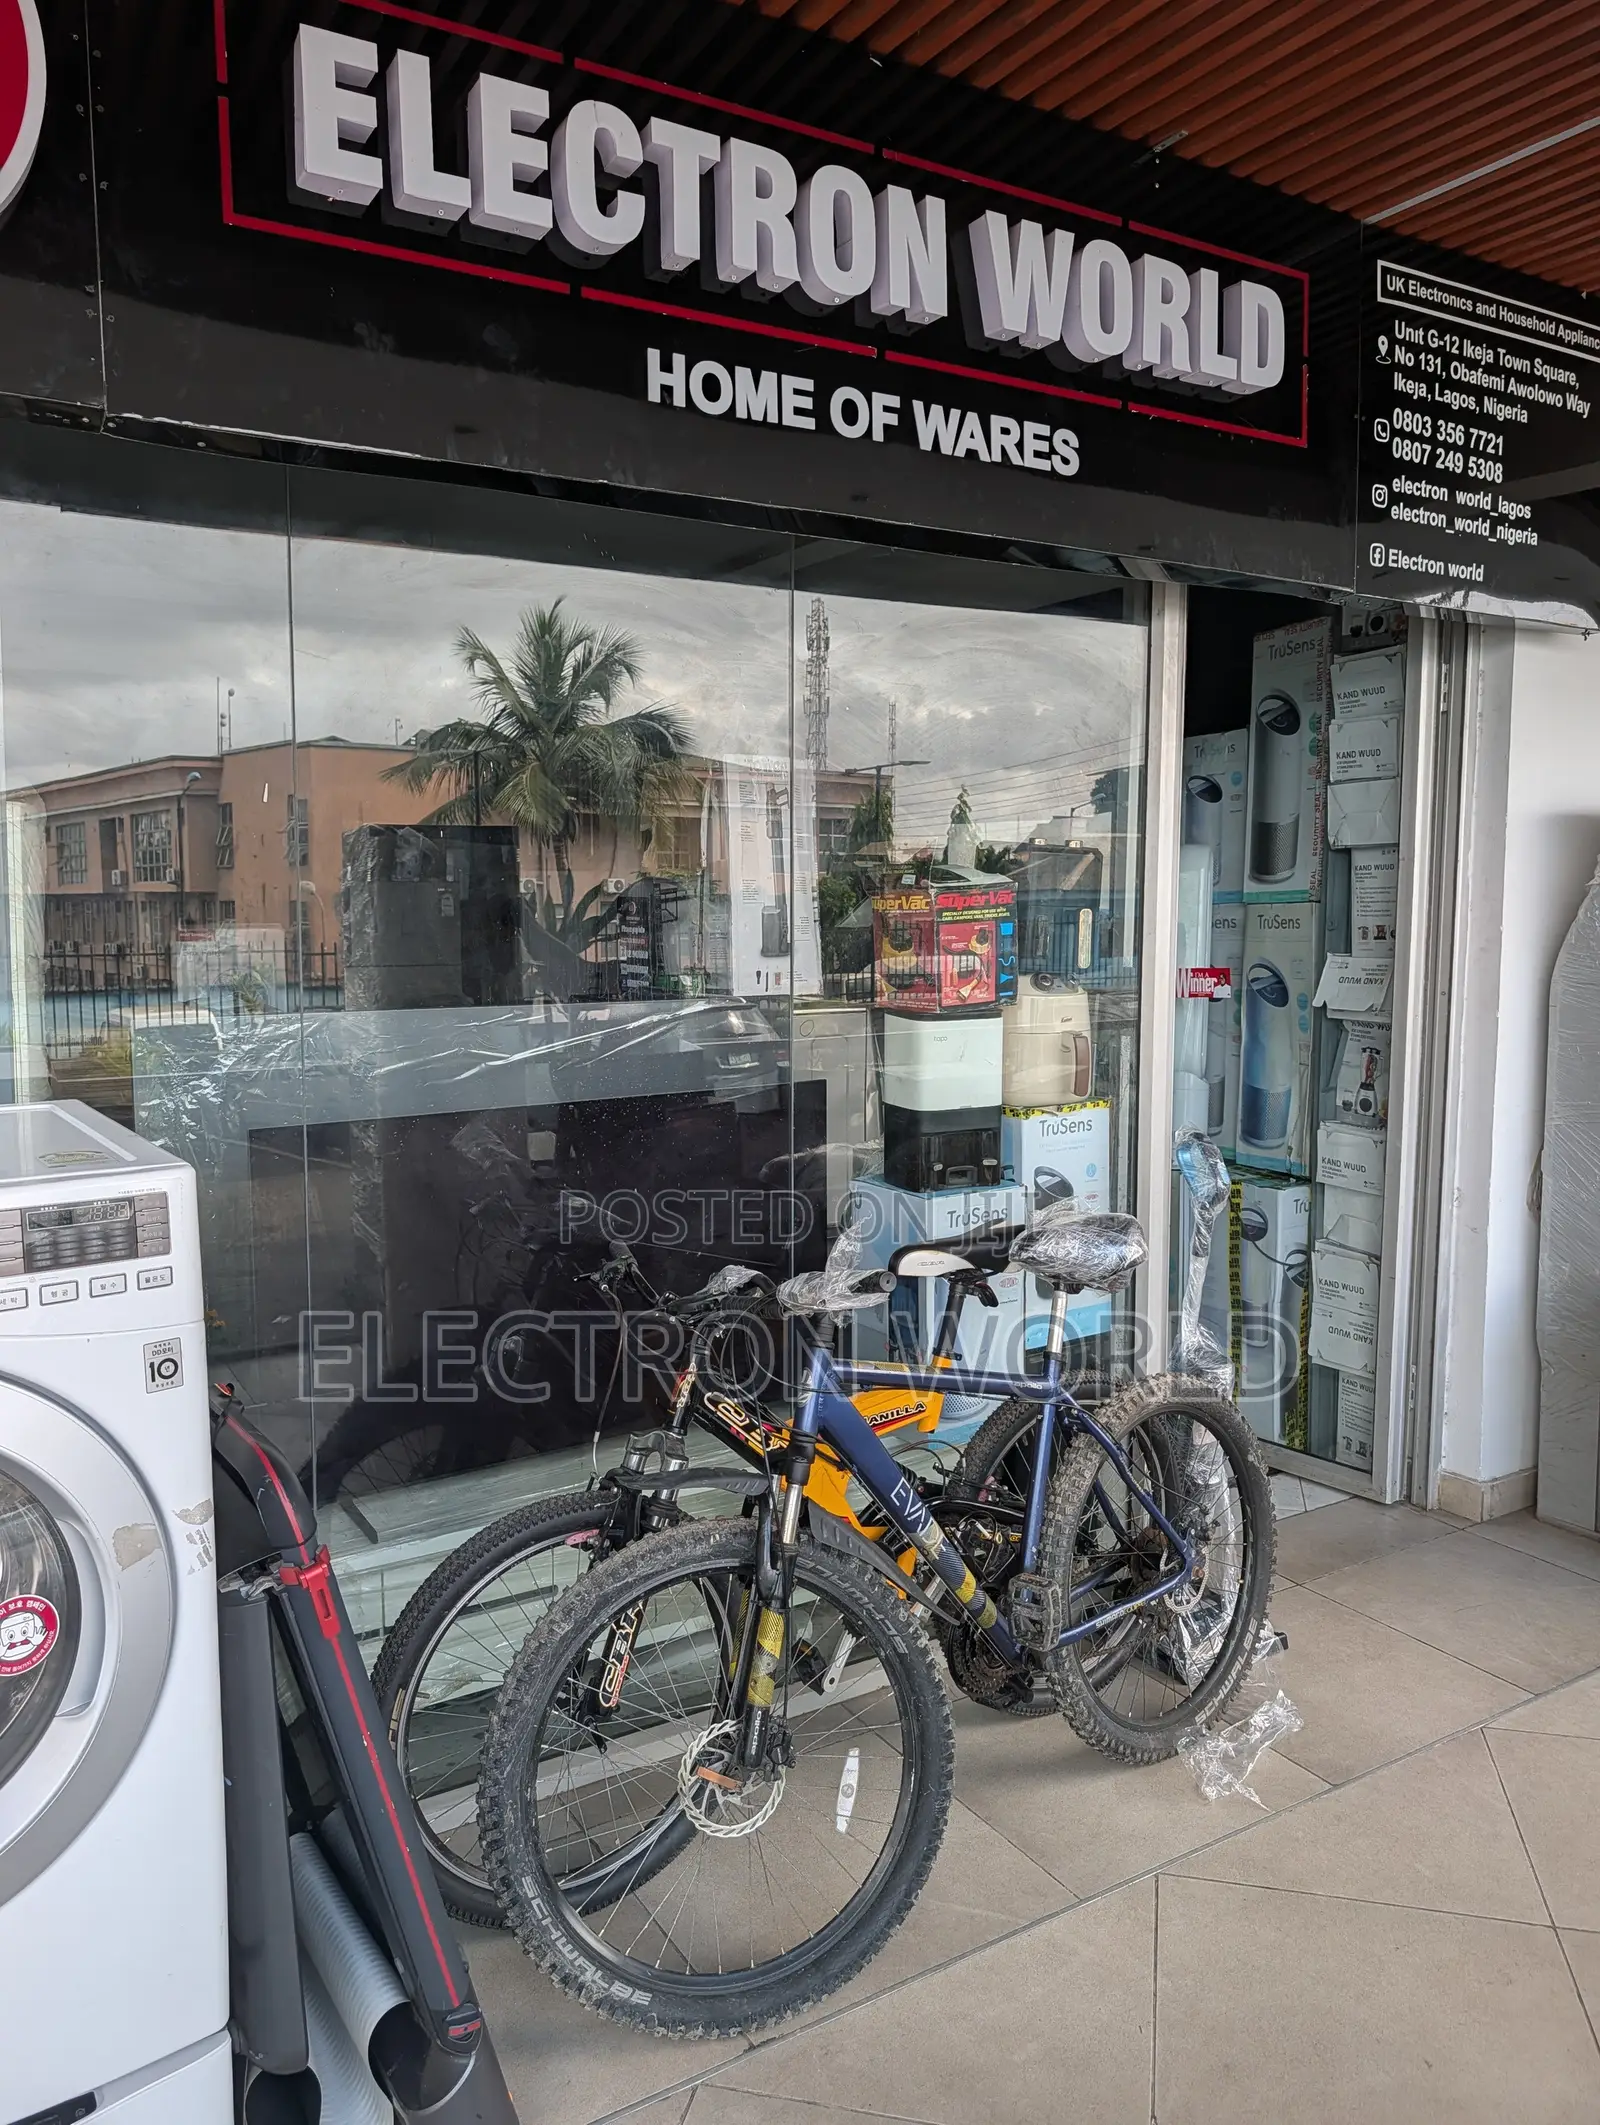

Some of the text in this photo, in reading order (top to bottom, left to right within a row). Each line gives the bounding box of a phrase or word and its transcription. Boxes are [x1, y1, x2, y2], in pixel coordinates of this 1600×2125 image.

[294, 24, 1284, 395] ELECTRON WORLD
[1387, 274, 1405, 293] UK
[1408, 277, 1473, 312] Electronics
[1476, 300, 1496, 318] and
[1499, 305, 1555, 336] Household
[1395, 319, 1580, 390] Unit G-12 Ikeja Town Square,
[1393, 371, 1528, 424] Ikeja, Lagos, Nigeria
[1394, 344, 1591, 419] No 131, Obafemi Awolowo Way
[646, 347, 1080, 477] HOME OF WARES
[1392, 407, 1504, 456] 0803 356 7721
[1392, 437, 1503, 484] 0807 249 5308
[1392, 475, 1448, 501] electron
[1391, 502, 1538, 546] electron_world_nigeria
[1388, 548, 1485, 582] Electron world
[1337, 686, 1386, 701] KAND WUUD
[1336, 748, 1381, 760] KAND WUUD
[1354, 864, 1372, 872] KAND
[1176, 968, 1217, 998] Winner
[1039, 1118, 1093, 1138] TruSens
[1321, 1156, 1342, 1168] KAND
[1343, 1162, 1366, 1173] WUUD
[1318, 1277, 1339, 1289] KAND
[1341, 1283, 1365, 1295] WUUD
[149, 1357, 179, 1383] 10
[1359, 1383, 1375, 1394] WUU
[1194, 1616, 1258, 1726] SCHWALBE
[521, 1875, 653, 2006] SCHWALBE
